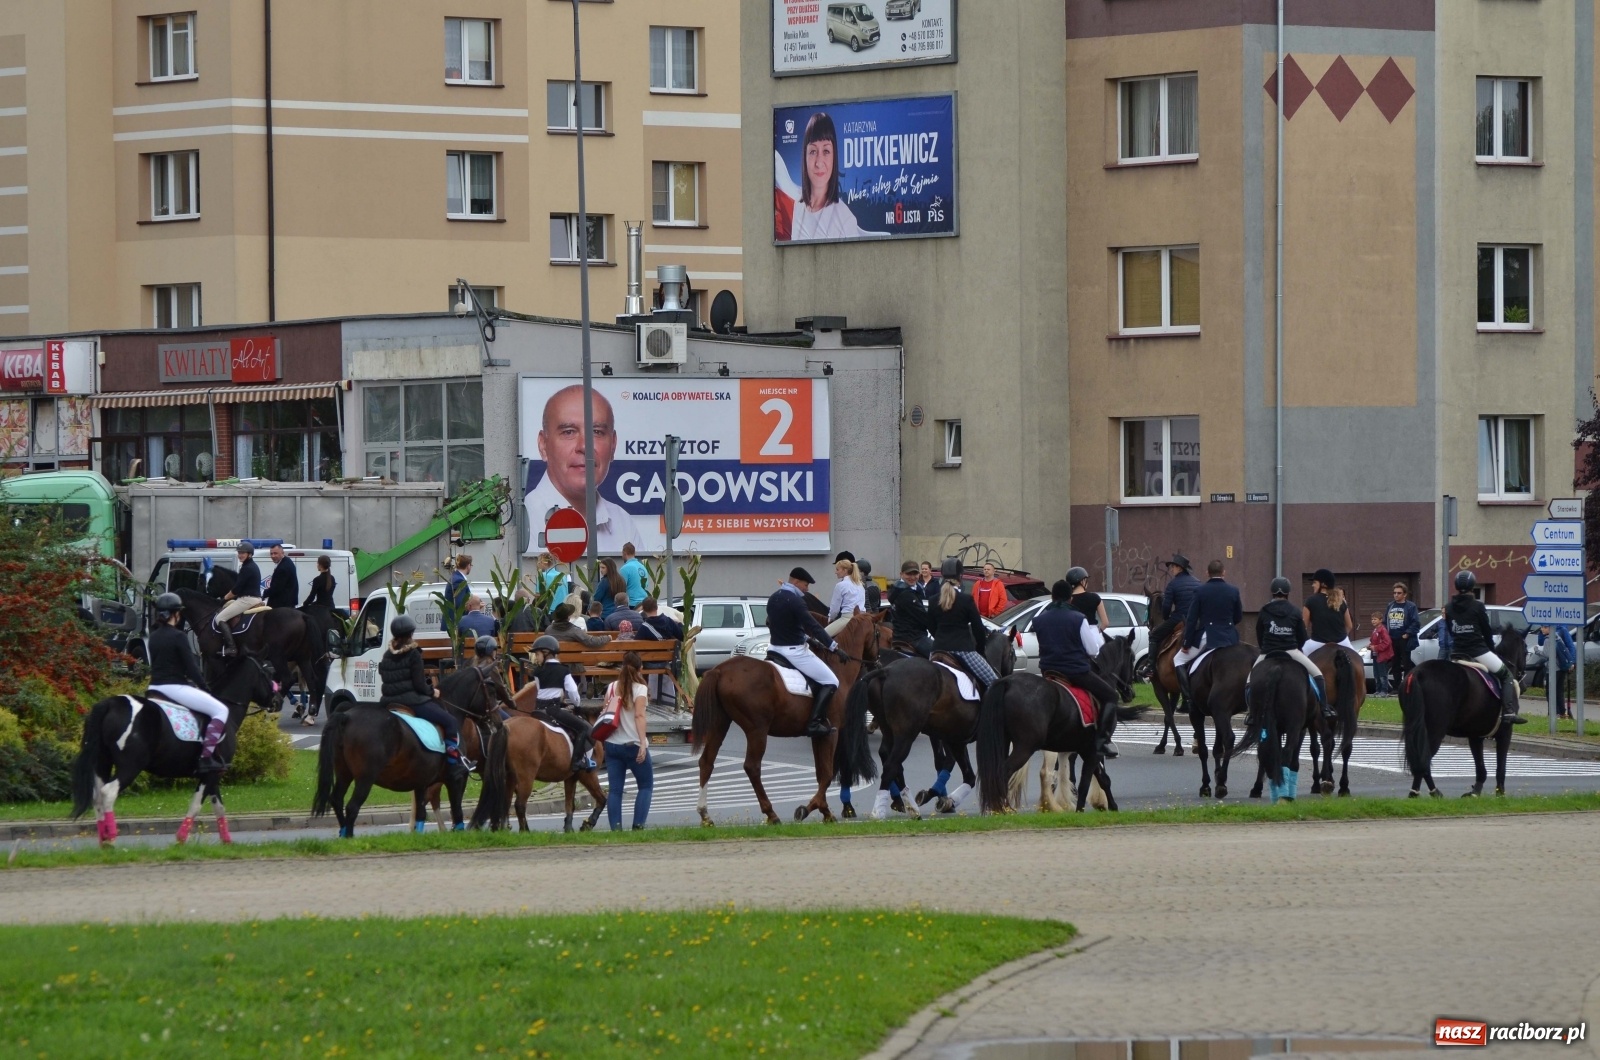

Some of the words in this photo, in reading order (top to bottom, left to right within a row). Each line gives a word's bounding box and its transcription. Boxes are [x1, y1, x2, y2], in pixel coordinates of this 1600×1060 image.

[921, 18, 944, 28] KONTAKT:
[783, 31, 798, 40] Monika
[798, 30, 809, 39] Klein
[843, 121, 877, 134] KATARZYNA
[843, 132, 939, 169] DUTKIEWICZ
[910, 173, 940, 195] Sejmie
[885, 212, 895, 225] NR
[895, 202, 903, 224] 6
[903, 210, 921, 223] LISTA
[927, 209, 945, 222] PiS
[51, 343, 60, 388] KEBAB
[163, 347, 229, 377] KWIATY
[632, 391, 670, 402] KOALICJA
[671, 391, 731, 402] OBYWATELSKA
[759, 398, 794, 456] 2
[625, 440, 720, 455] KRZYZTOF
[616, 470, 814, 503] GADOWSKI
[1557, 505, 1578, 513] Starówka
[707, 519, 713, 529] Z
[716, 519, 750, 529] SIEBIE
[753, 518, 814, 528] WSZYSTKO!
[1544, 527, 1575, 540] Centrum
[1549, 554, 1580, 567] Dworzec
[1543, 580, 1569, 594] Poczta
[1531, 606, 1552, 621] Urząd
[1555, 606, 1581, 619] Miasta
